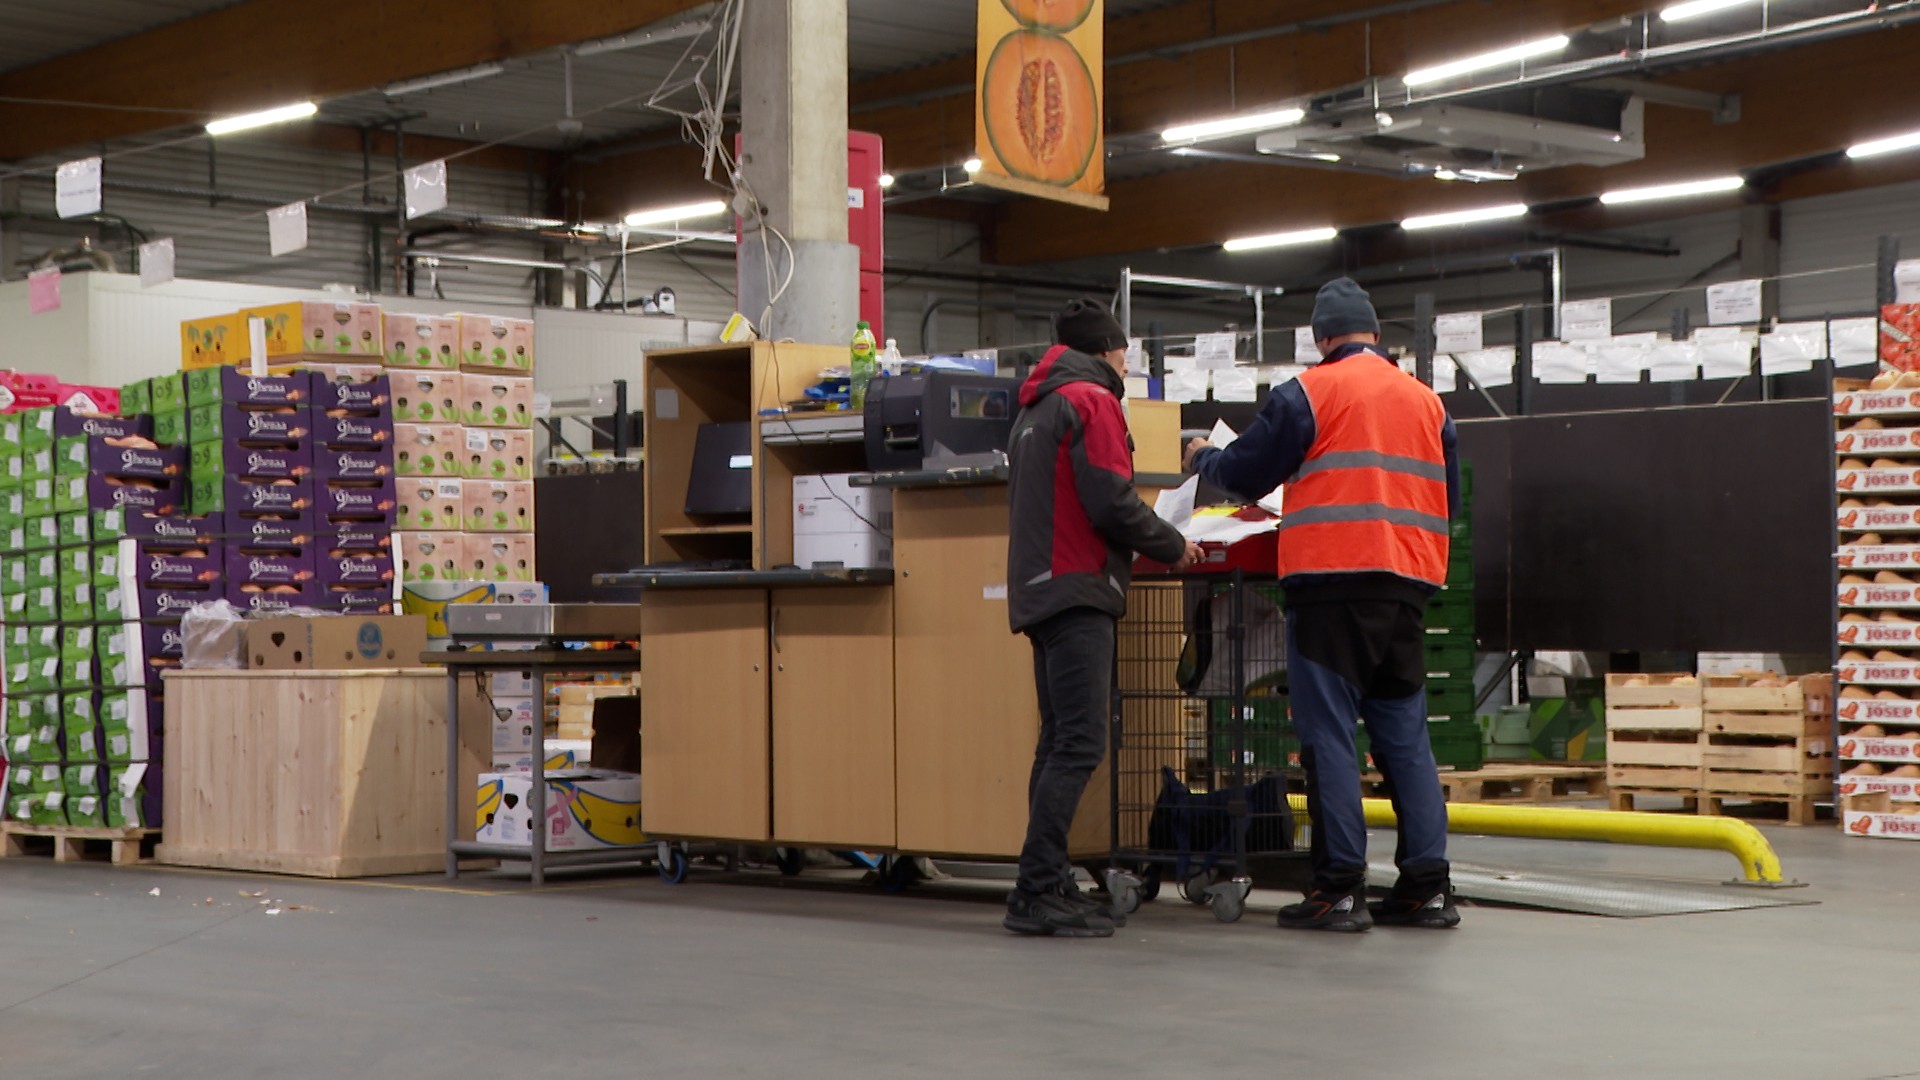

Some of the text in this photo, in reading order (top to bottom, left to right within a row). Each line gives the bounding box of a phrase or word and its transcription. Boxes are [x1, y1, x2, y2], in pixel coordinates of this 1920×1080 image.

[1861, 397, 1905, 410] JOSEP
[1862, 435, 1906, 449] JOSEP
[1864, 474, 1909, 487] JOSEP
[1865, 513, 1909, 525] JOSEP
[1864, 552, 1908, 563] JOSEP
[1865, 591, 1910, 603] JOSEP
[1866, 630, 1911, 641] JOSEP
[1864, 669, 1909, 680] JOSEP
[1866, 706, 1912, 718] JOSEP
[1864, 745, 1909, 756] JOSEP
